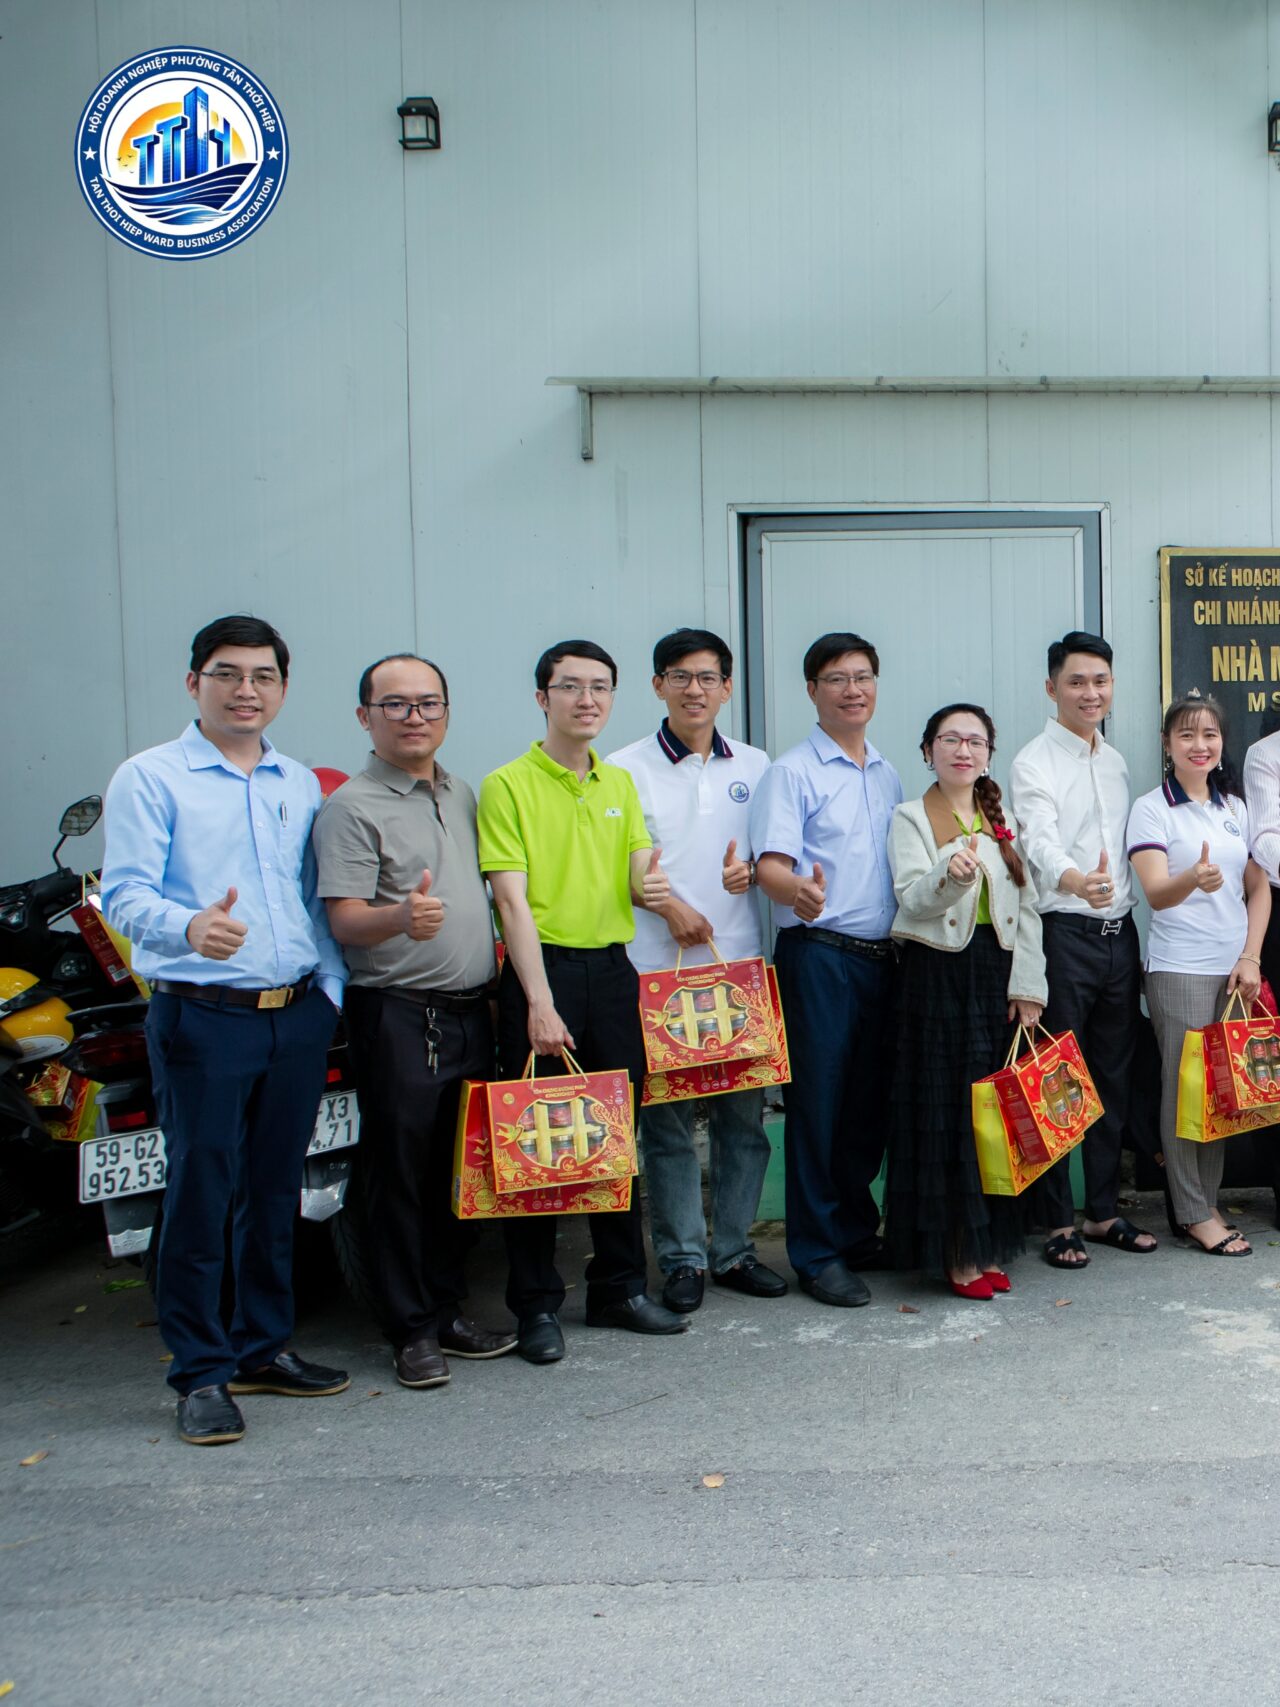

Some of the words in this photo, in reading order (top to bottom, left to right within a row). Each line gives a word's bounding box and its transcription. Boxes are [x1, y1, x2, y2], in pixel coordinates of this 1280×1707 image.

[1185, 562, 1204, 587] SỞ
[1208, 562, 1228, 587] KẾ
[1231, 568, 1280, 591] HOẠCH
[1193, 600, 1221, 625] CHI
[1212, 639, 1265, 682] NHÀ
[96, 1133, 159, 1168] 59-G2
[89, 1160, 165, 1197] 952.53
